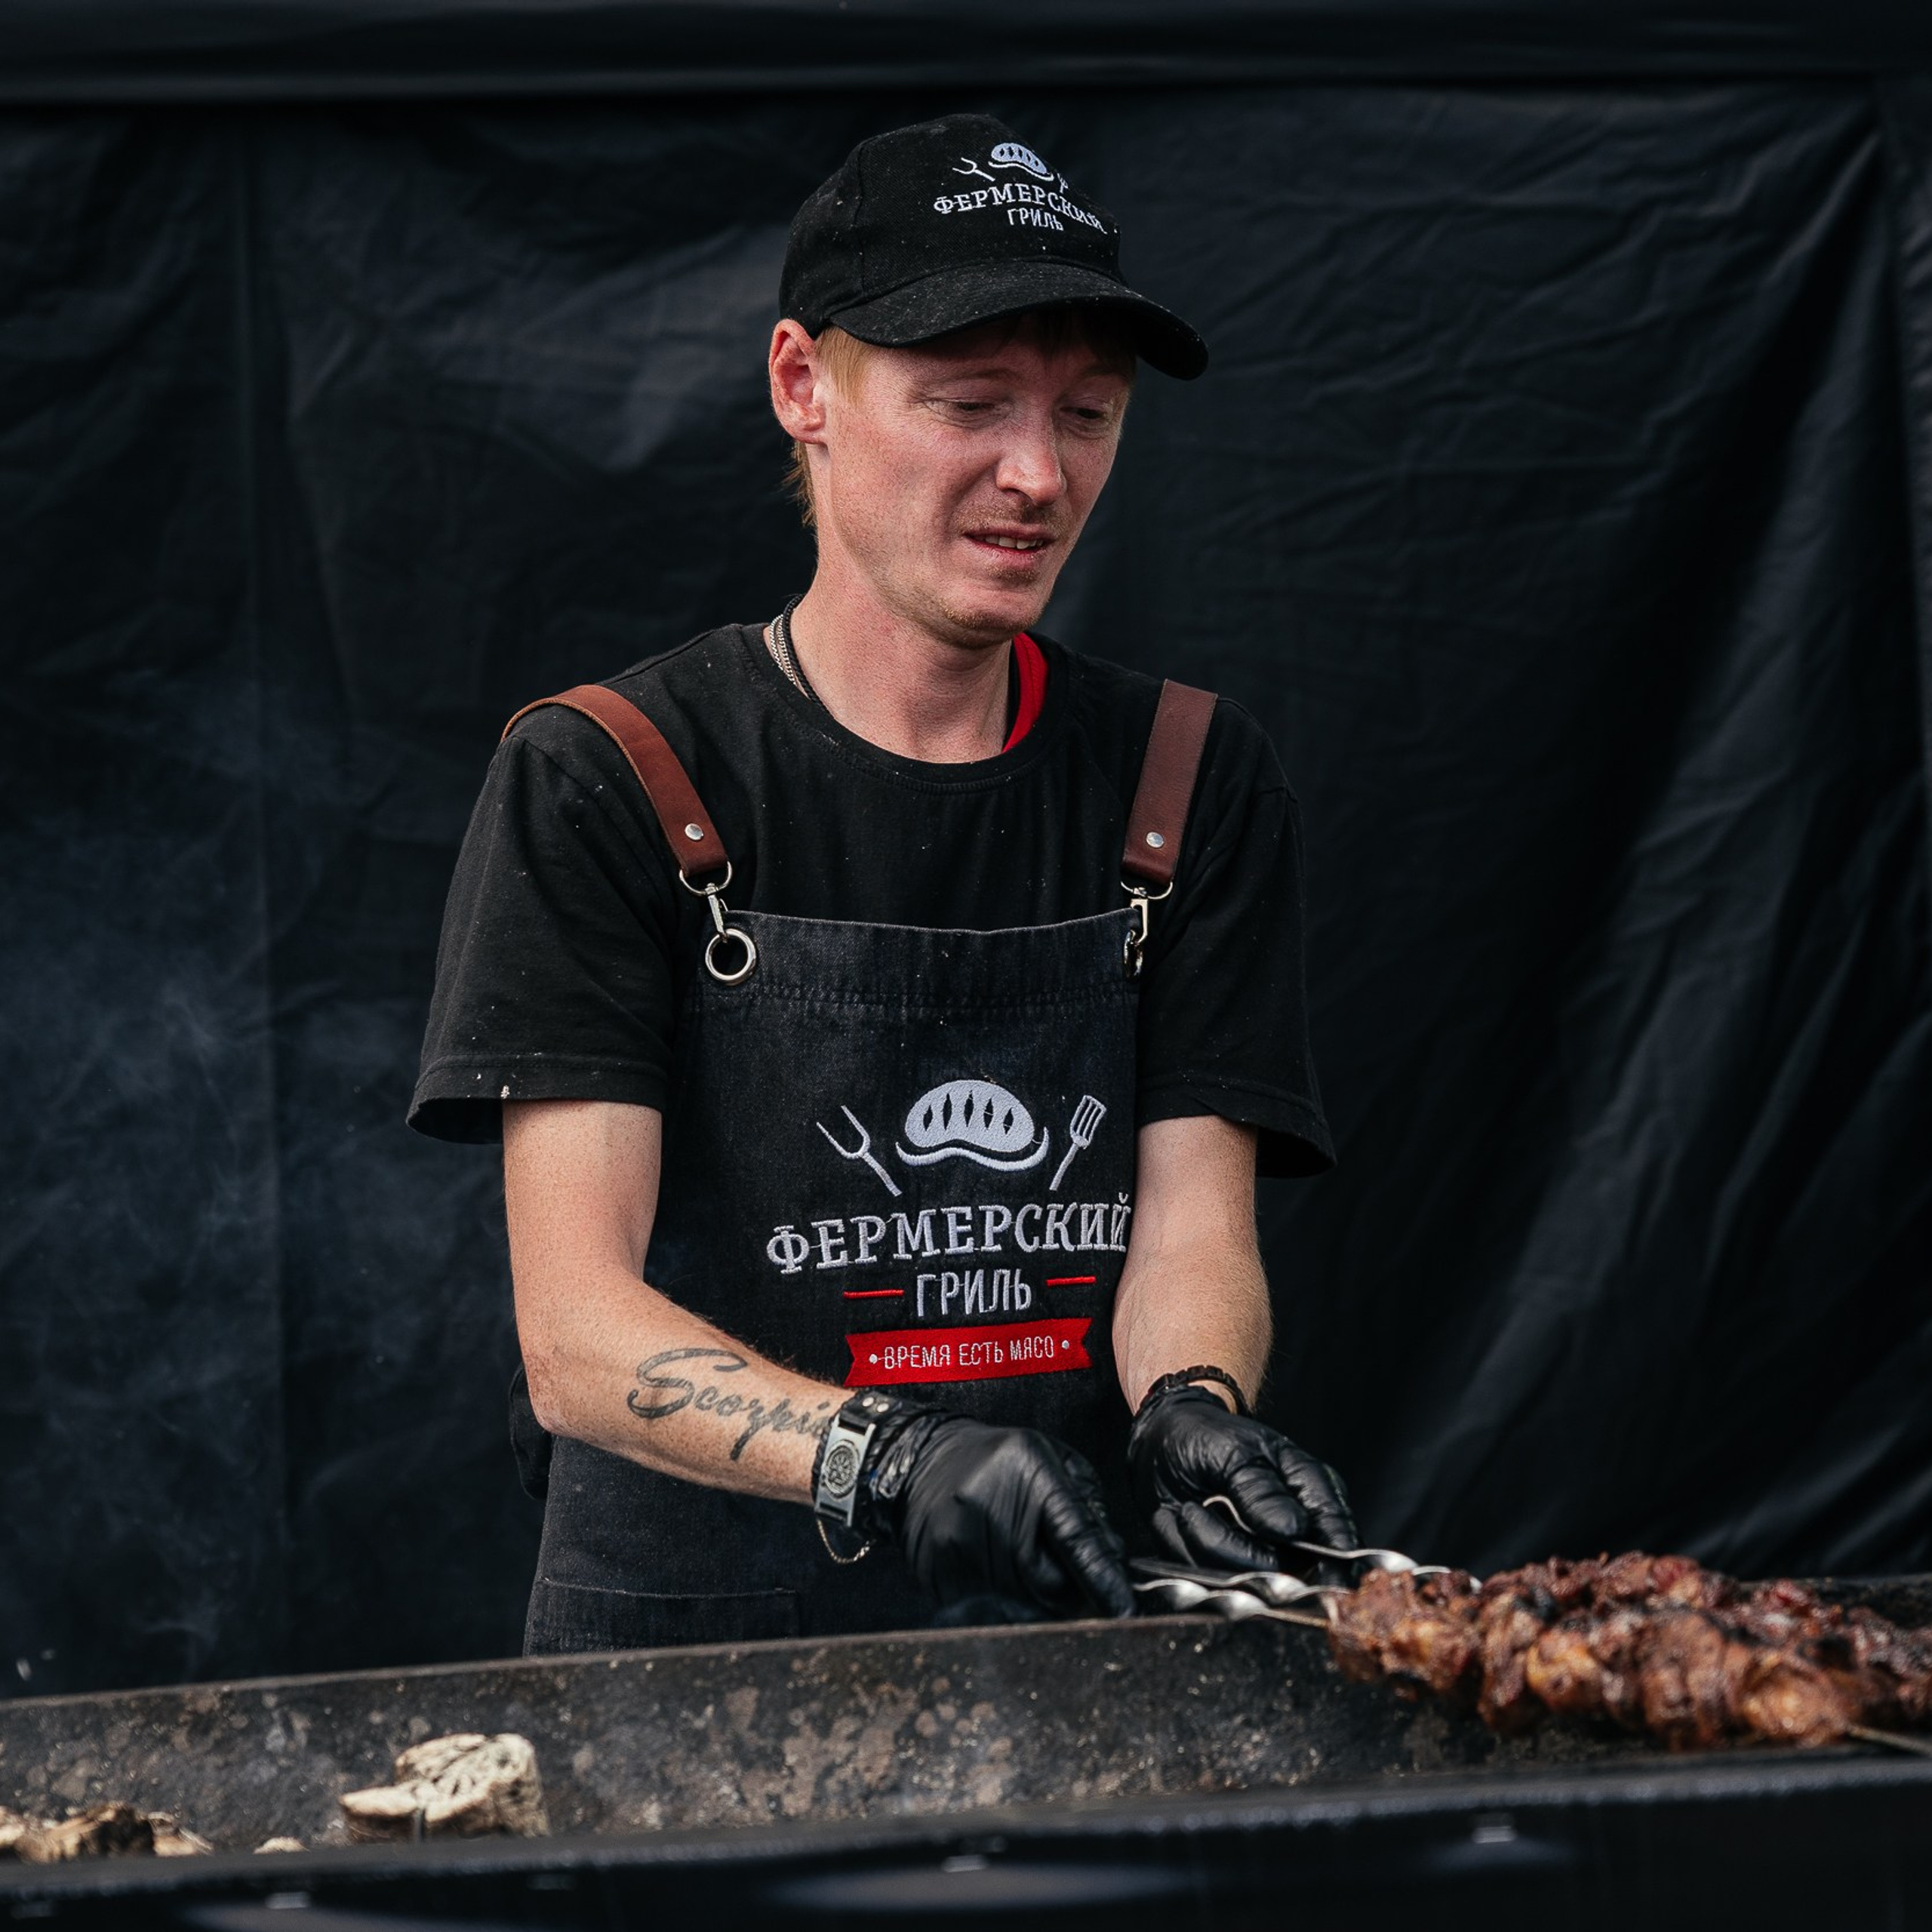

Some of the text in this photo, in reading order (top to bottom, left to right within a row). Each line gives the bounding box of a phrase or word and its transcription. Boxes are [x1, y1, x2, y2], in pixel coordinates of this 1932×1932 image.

[1008, 208, 1064, 232] ГРИЛЬ
[765, 1192, 1131, 1274] ФЕРМЕРСКИЙ
[916, 1269, 1032, 1316] ГРИЛЬ
[884, 1336, 1054, 1369] ВРЕМЯ ЕСТЬ МЯСО
